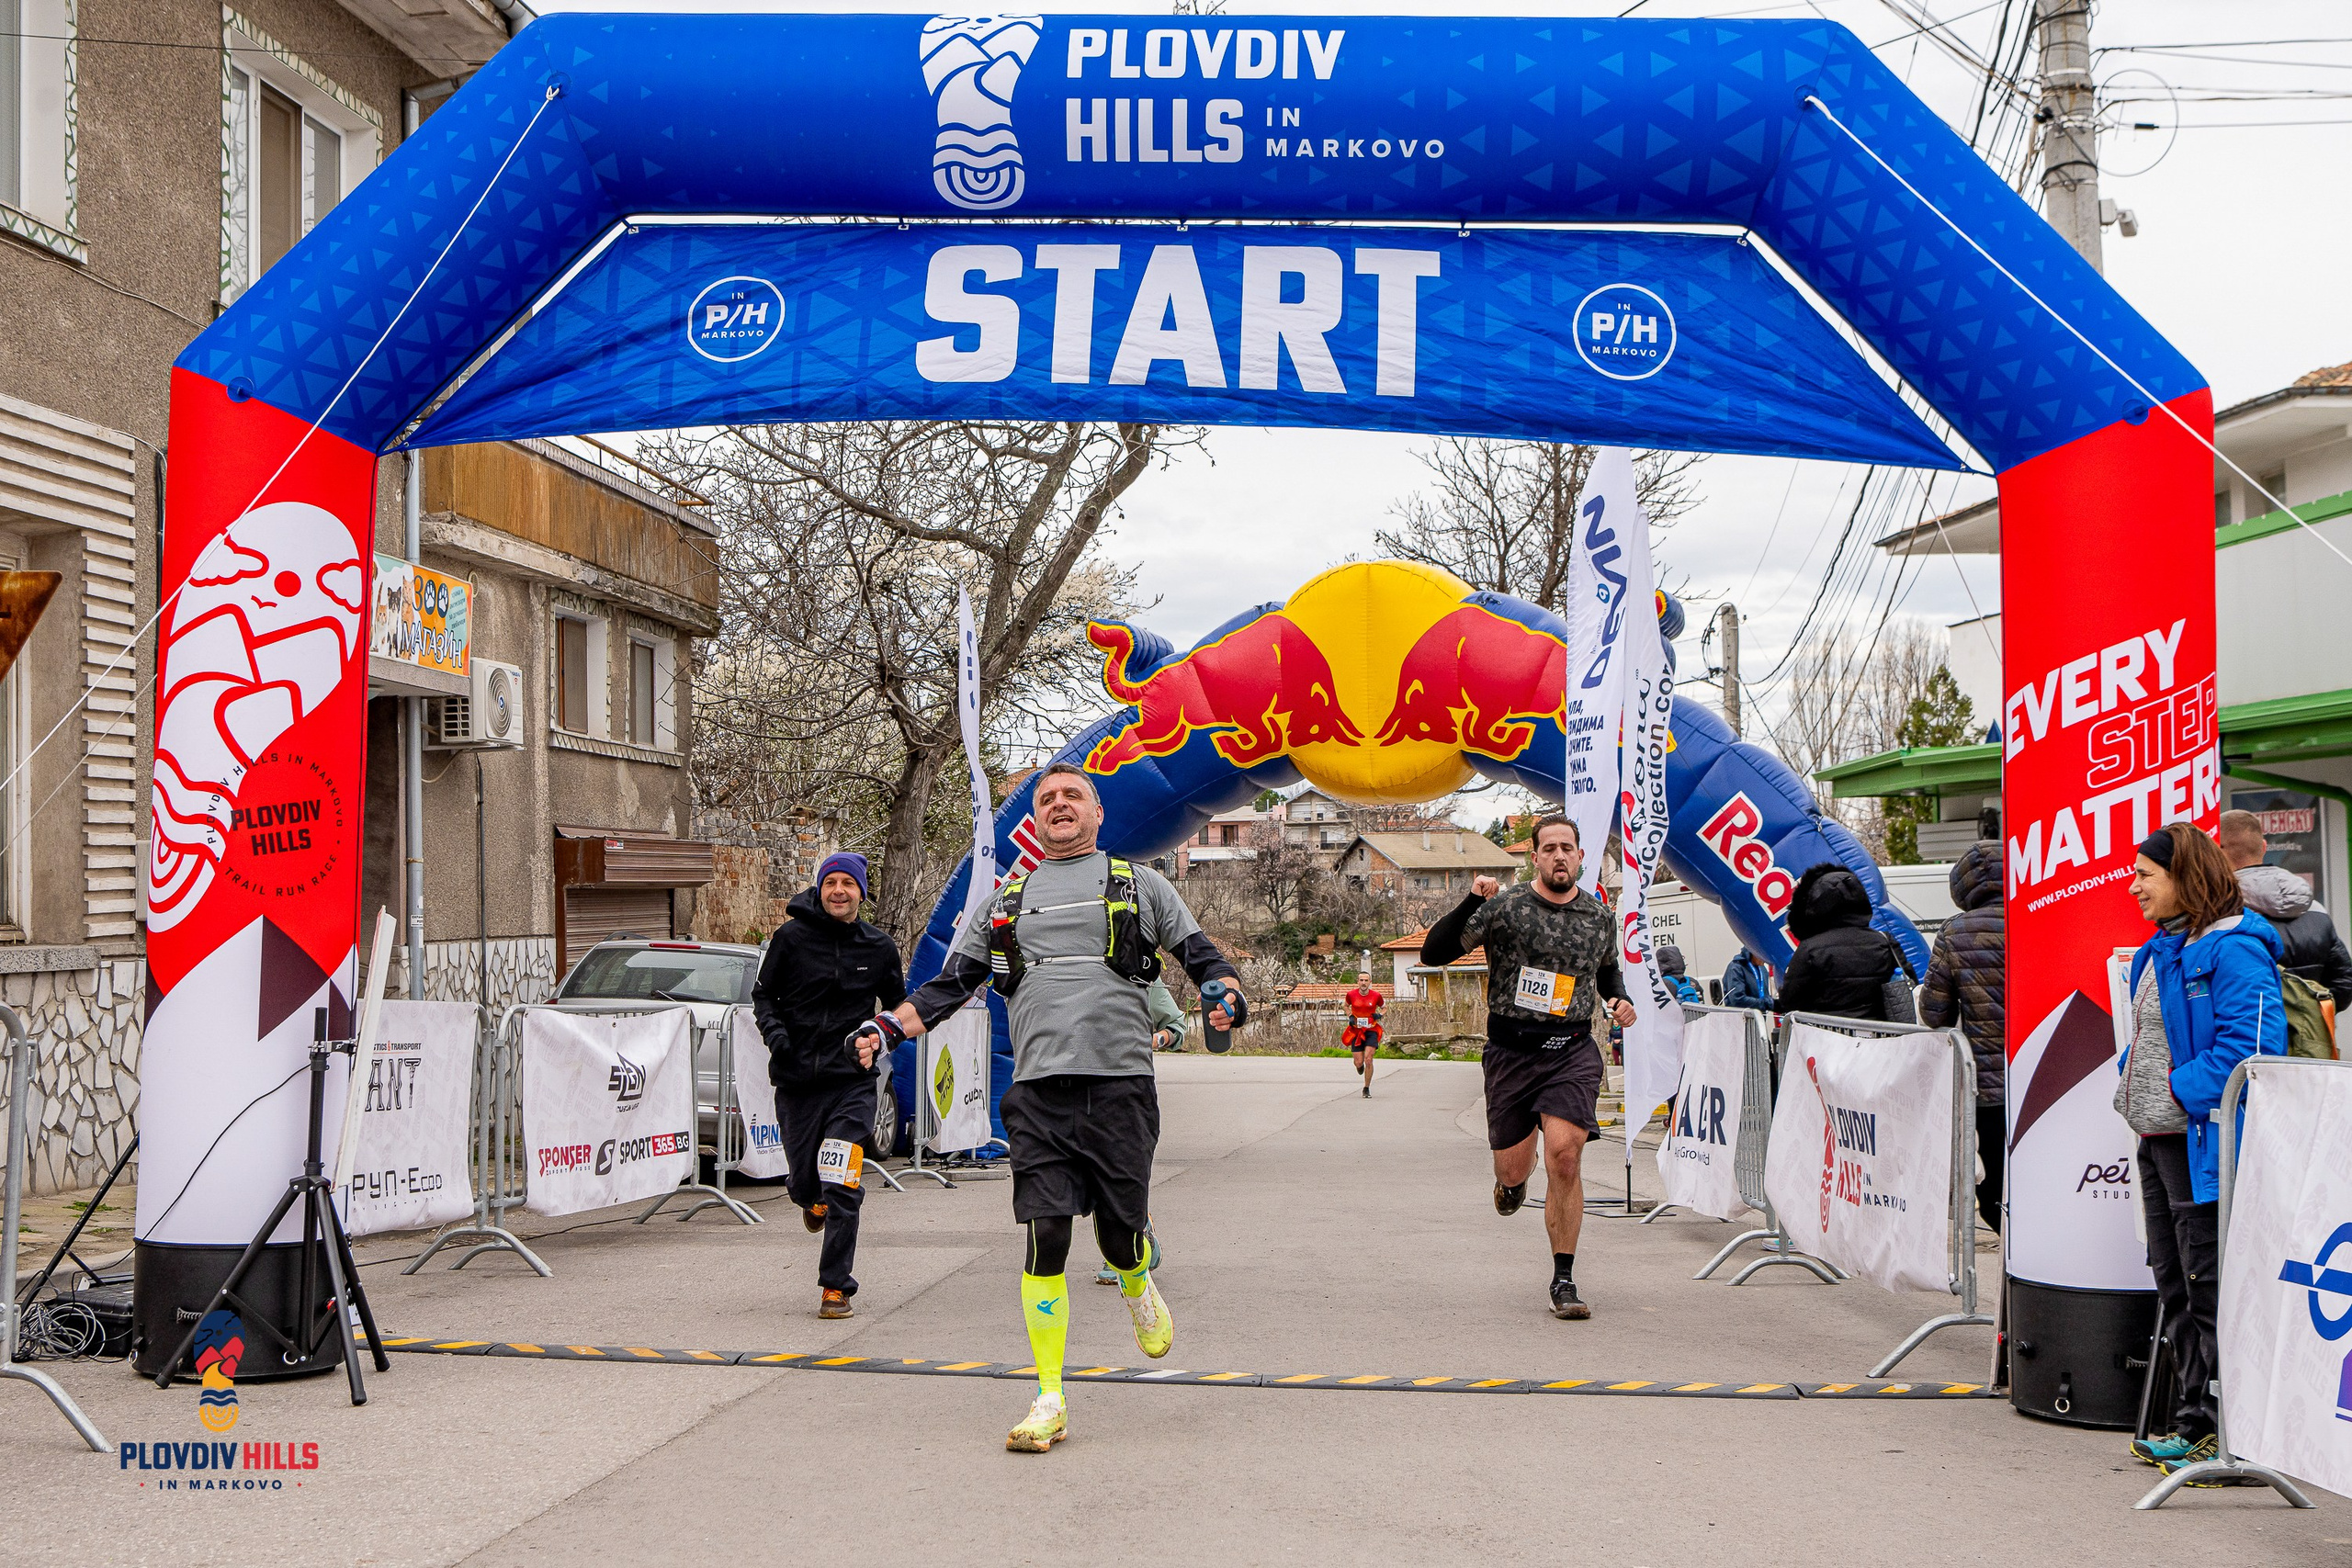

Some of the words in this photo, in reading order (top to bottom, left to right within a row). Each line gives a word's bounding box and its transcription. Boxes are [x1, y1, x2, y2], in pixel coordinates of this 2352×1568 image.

[1067, 28, 1346, 80] PLOVDIV
[1066, 97, 1244, 164] HILLS
[1266, 107, 1300, 127] IN
[1266, 139, 1445, 158] MARKOVO
[705, 302, 769, 330] P/H
[915, 244, 1441, 398] START
[1591, 312, 1657, 344] P/H
[701, 330, 764, 339] MARKOVO
[1592, 346, 1657, 357] MARKOVO
[401, 621, 463, 669] МАГАЗИН
[2006, 618, 2187, 763] EVERY
[2086, 671, 2217, 788] STEP
[206, 778, 230, 844] PLOVDIV
[233, 752, 278, 776] HILLS
[288, 753, 303, 765] IN
[310, 762, 343, 828] MARKOVO
[231, 799, 322, 830] PLOVDIV
[251, 829, 311, 856] HILLS
[224, 867, 266, 896] TRAIL
[277, 886, 306, 897] RUN
[311, 854, 337, 886] RACE
[1651, 914, 1681, 928] CHEL
[1521, 978, 1548, 997] 1128
[391, 1043, 422, 1051] TRANSPORT
[750, 1124, 782, 1146] ALPIN
[537, 1145, 592, 1178] SPONSER
[820, 1151, 844, 1168] 1231
[2093, 1190, 2131, 1200] STUD
